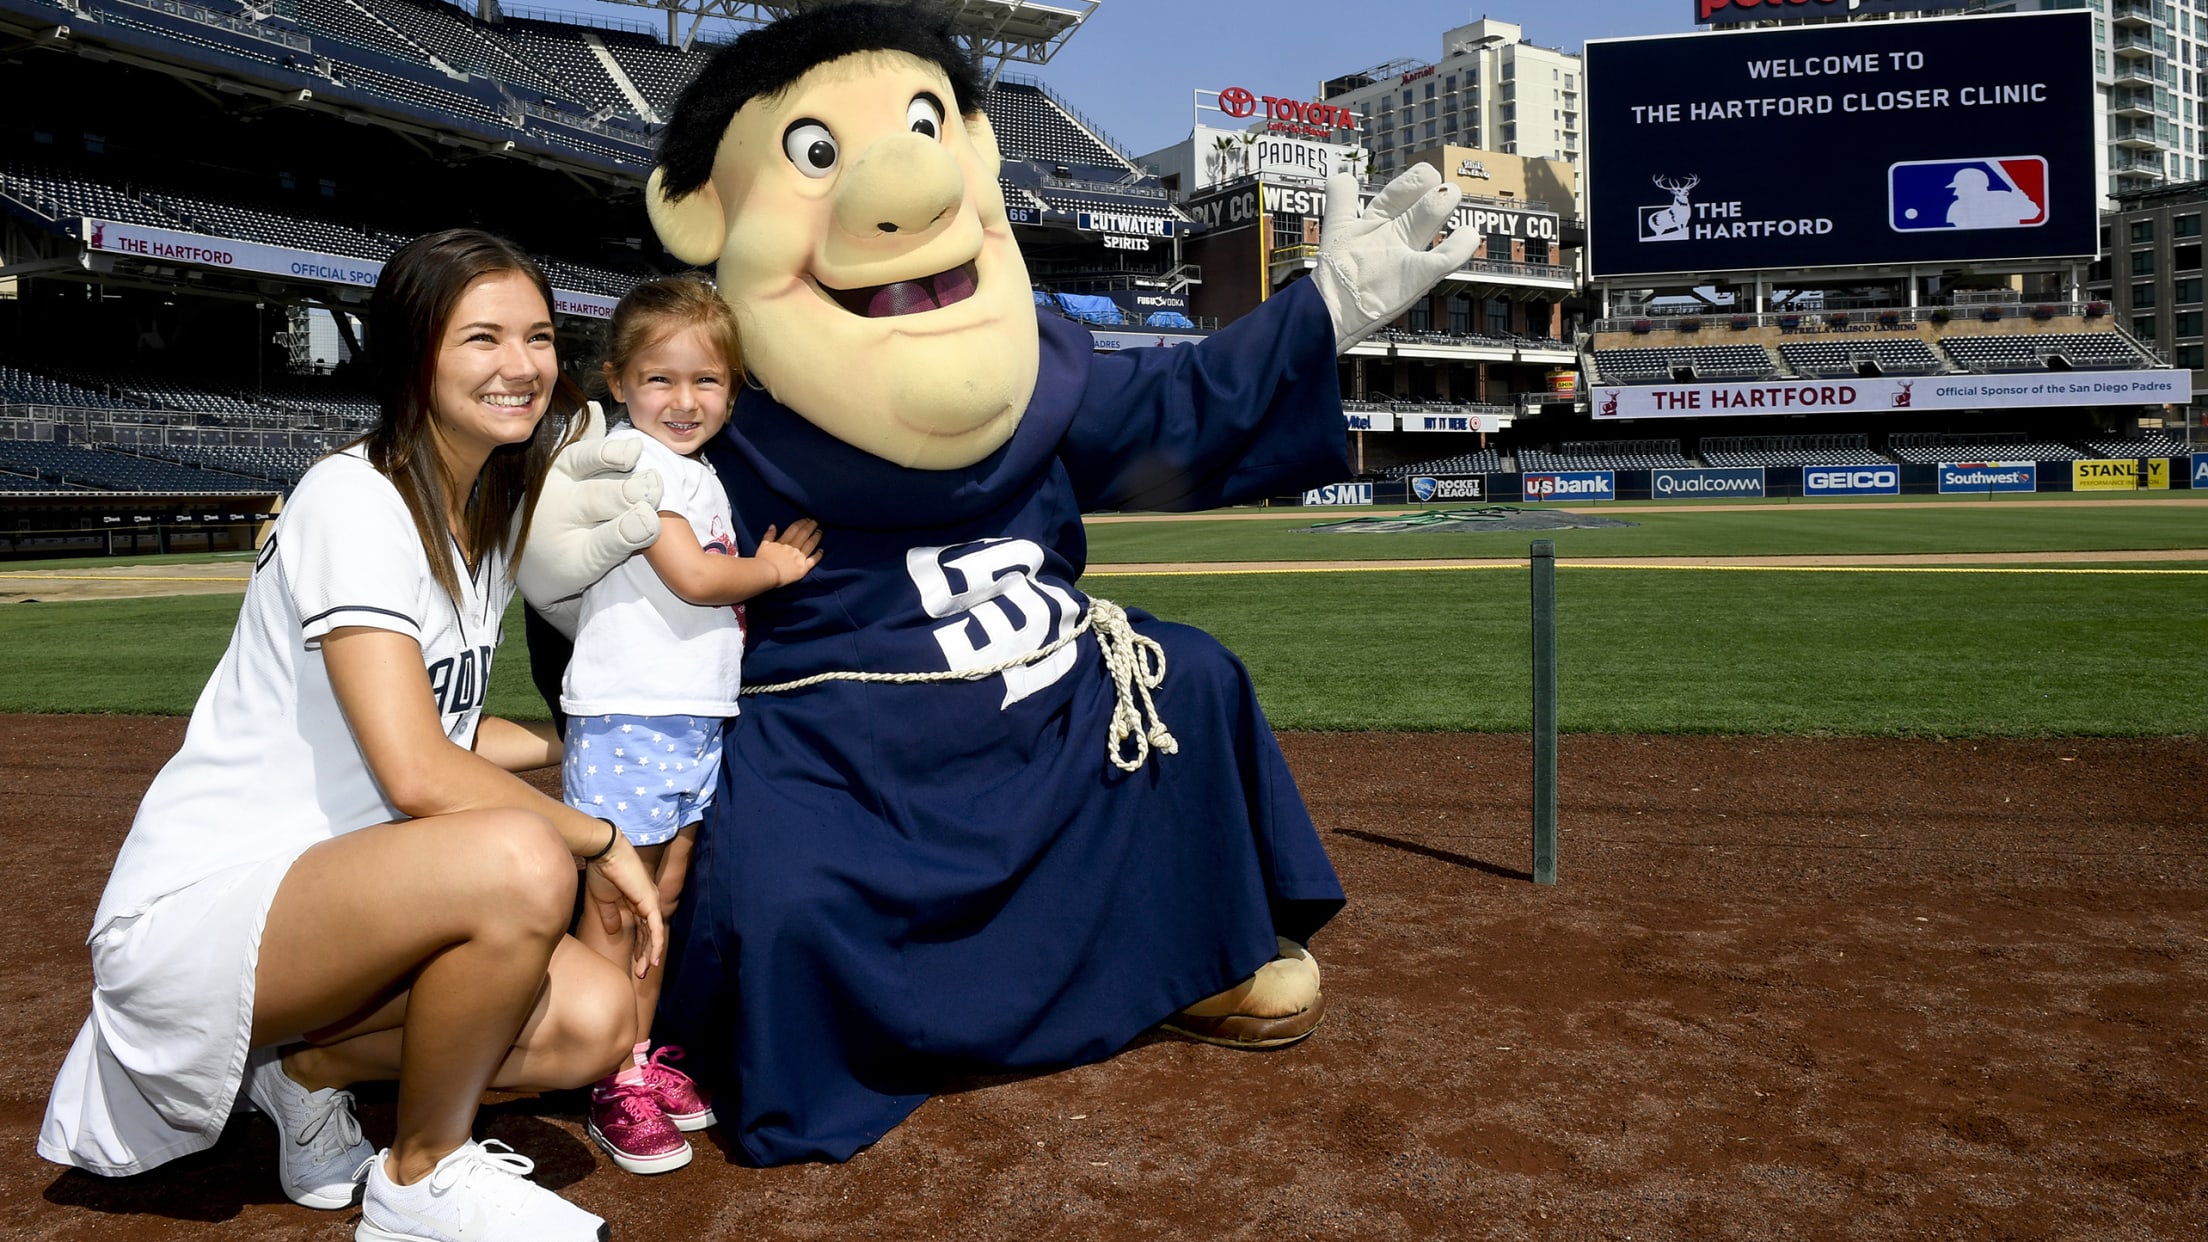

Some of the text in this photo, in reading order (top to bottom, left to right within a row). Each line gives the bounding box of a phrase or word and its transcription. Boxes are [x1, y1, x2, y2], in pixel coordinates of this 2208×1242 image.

[1747, 51, 1924, 79] WELCOME TO
[1262, 96, 1355, 130] TOYOTA
[1631, 83, 2047, 124] THE HARTFORD CLOSER CLINIC
[1258, 141, 1327, 178] PADRES
[1695, 201, 1742, 218] THE
[1090, 213, 1164, 235] CUTWATER
[1447, 209, 1557, 240] SUPPLY CO.
[1695, 218, 1833, 240] HARTFORD
[118, 237, 233, 265] THE HARTFORD
[1104, 236, 1149, 251] SPIRITS
[291, 262, 346, 281] OFFICIAL
[555, 300, 567, 311] HE
[1094, 340, 1120, 348] ADRES
[1652, 386, 1857, 409] THE HARTFORD
[1936, 382, 2172, 397] Official Sponsor of the San Diego Padres
[1437, 479, 1480, 489] ROCKET
[1656, 474, 1760, 494] Qualcomm
[1808, 471, 1895, 489] GEICO
[1945, 471, 2019, 484] Southwest
[1305, 484, 1372, 505] ASML
[1437, 488, 1480, 498] LEAGUE
